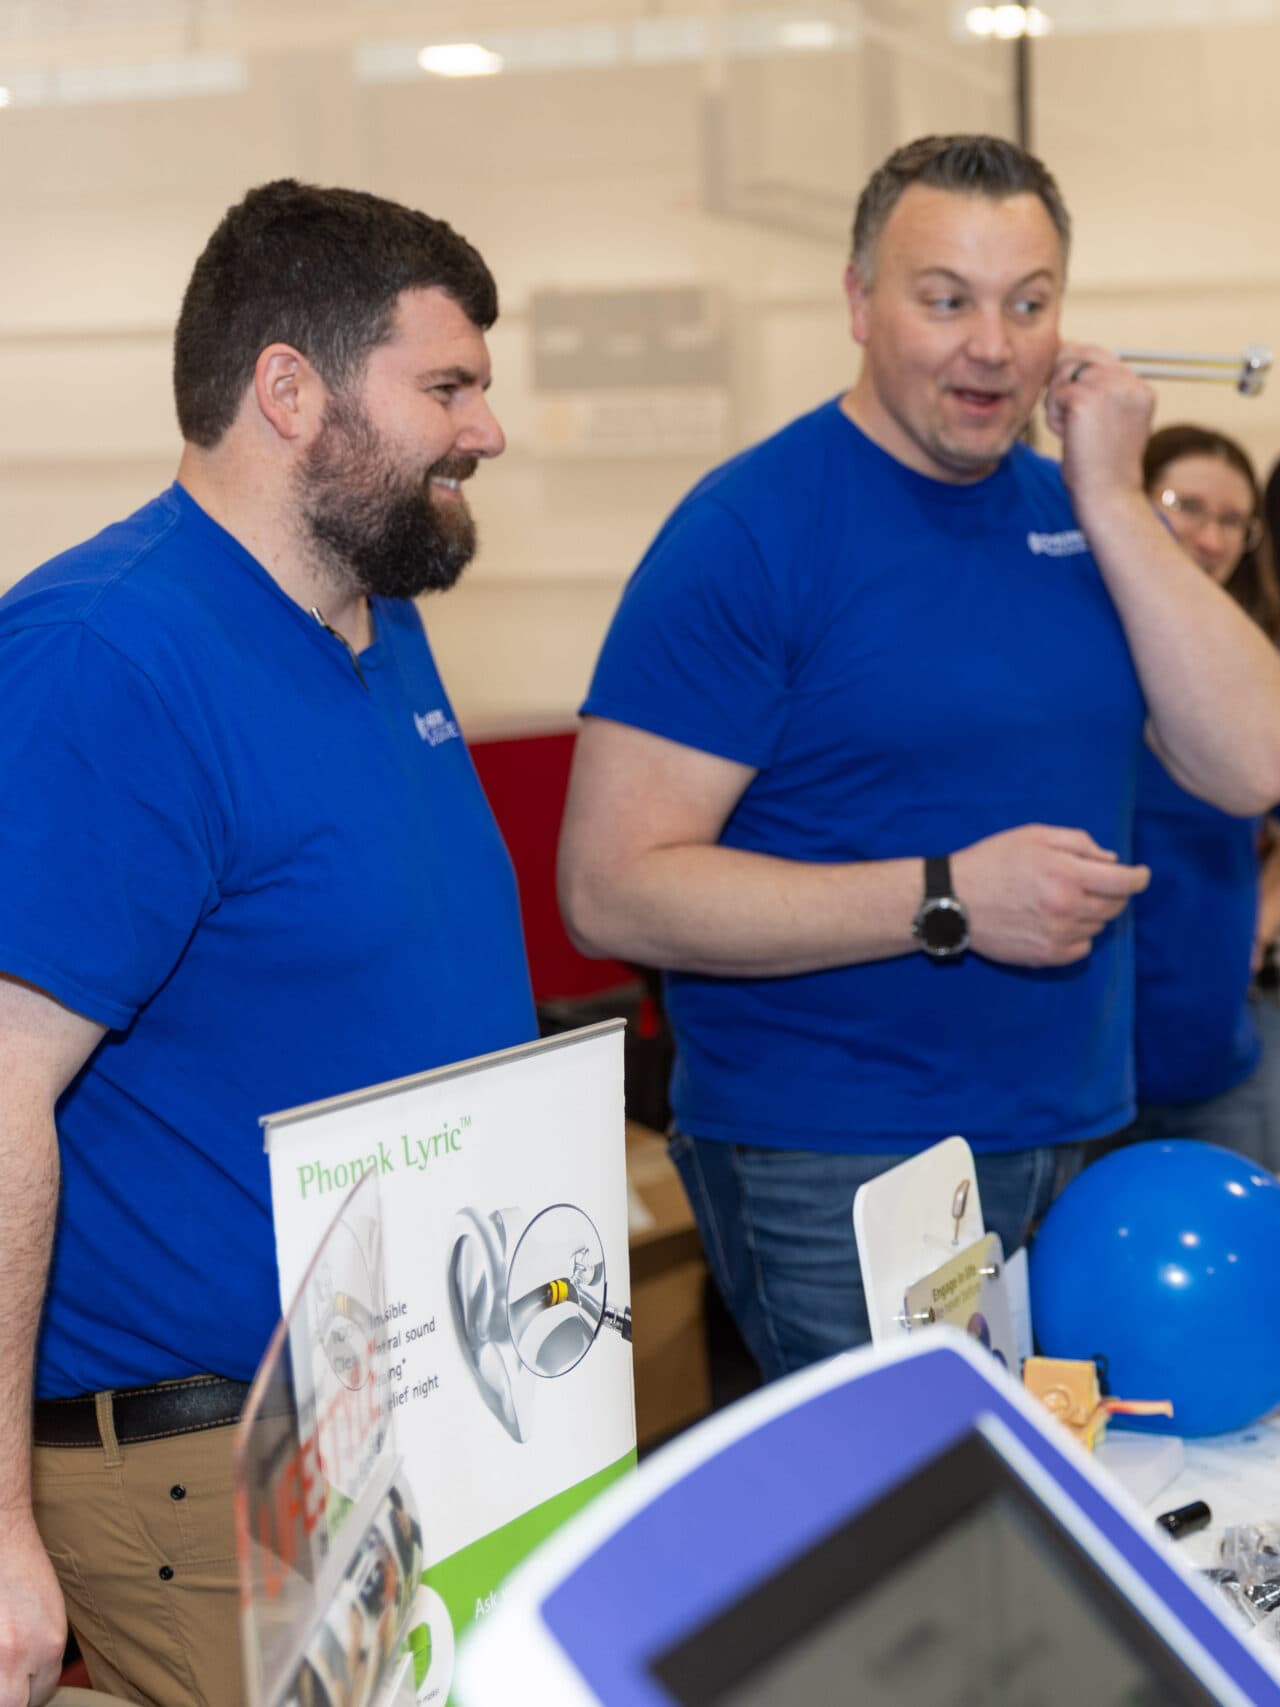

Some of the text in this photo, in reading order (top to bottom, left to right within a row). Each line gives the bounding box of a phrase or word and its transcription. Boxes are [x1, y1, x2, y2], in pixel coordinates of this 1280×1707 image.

[369, 1301, 407, 1330] Phonak
[405, 1314, 435, 1344] sound
[412, 1374, 439, 1400] night
